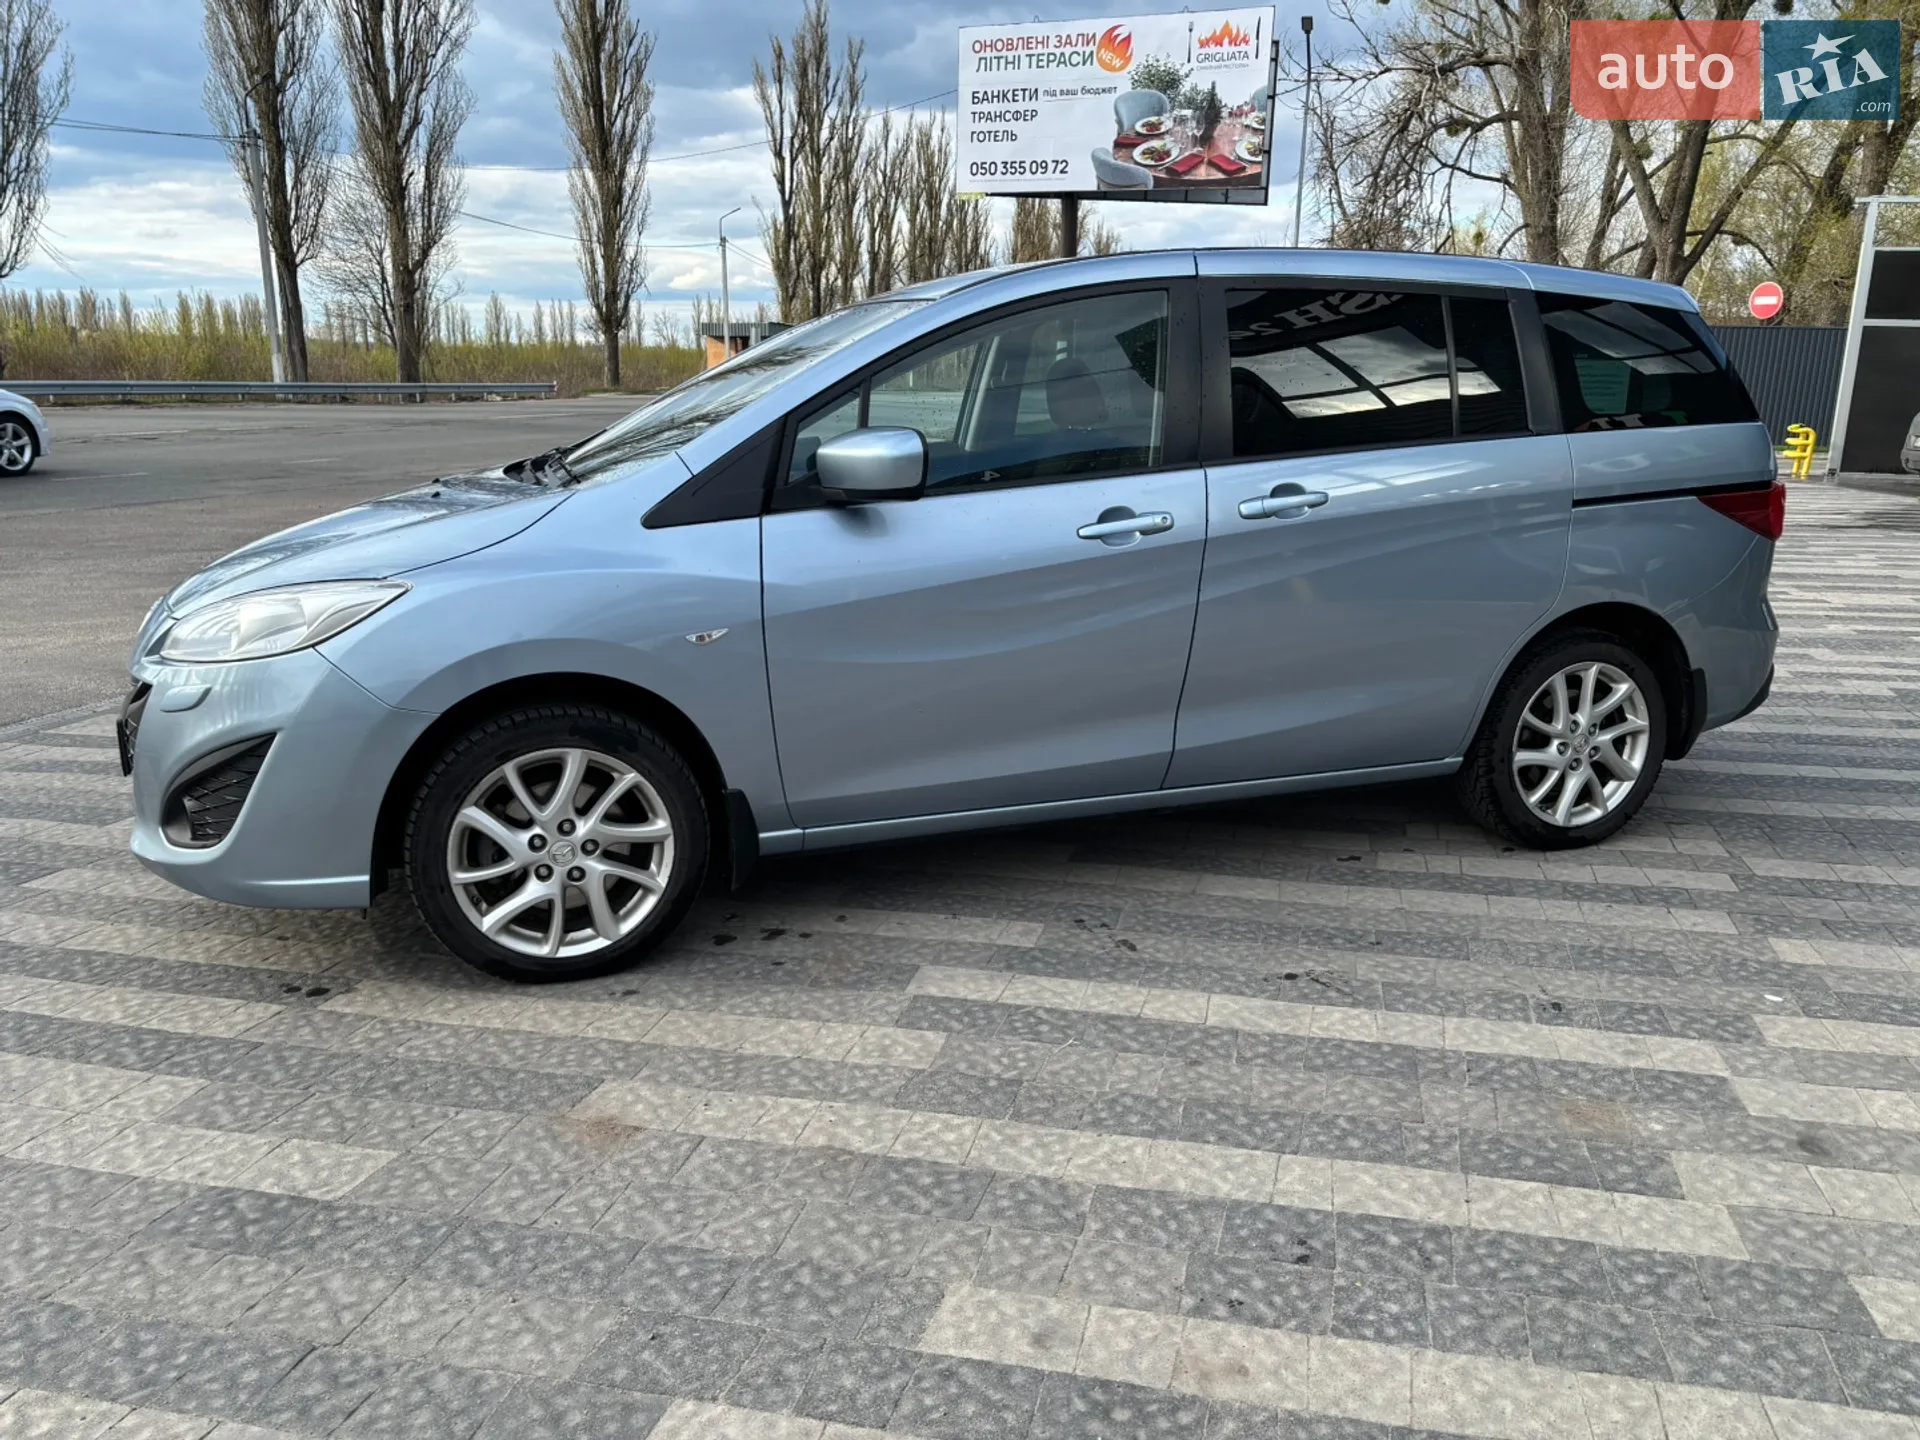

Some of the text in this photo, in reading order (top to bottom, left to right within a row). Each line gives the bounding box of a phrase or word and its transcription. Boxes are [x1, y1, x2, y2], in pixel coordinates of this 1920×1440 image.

[972, 32, 1097, 54] ОНОВЛЕНІ ЗАЛИ
[975, 50, 1094, 73] ЛІТНІ ТЕРАСИ
[1098, 48, 1124, 69] NEW
[1196, 50, 1250, 64] GRIGLIATA
[971, 85, 1118, 105] БАНКЕТИ під ваш бюджет
[970, 109, 1039, 124] ТРАНСФЕР
[970, 129, 1018, 143] ГОТЕЛЬ
[970, 159, 1069, 176] 050 355 09 72
